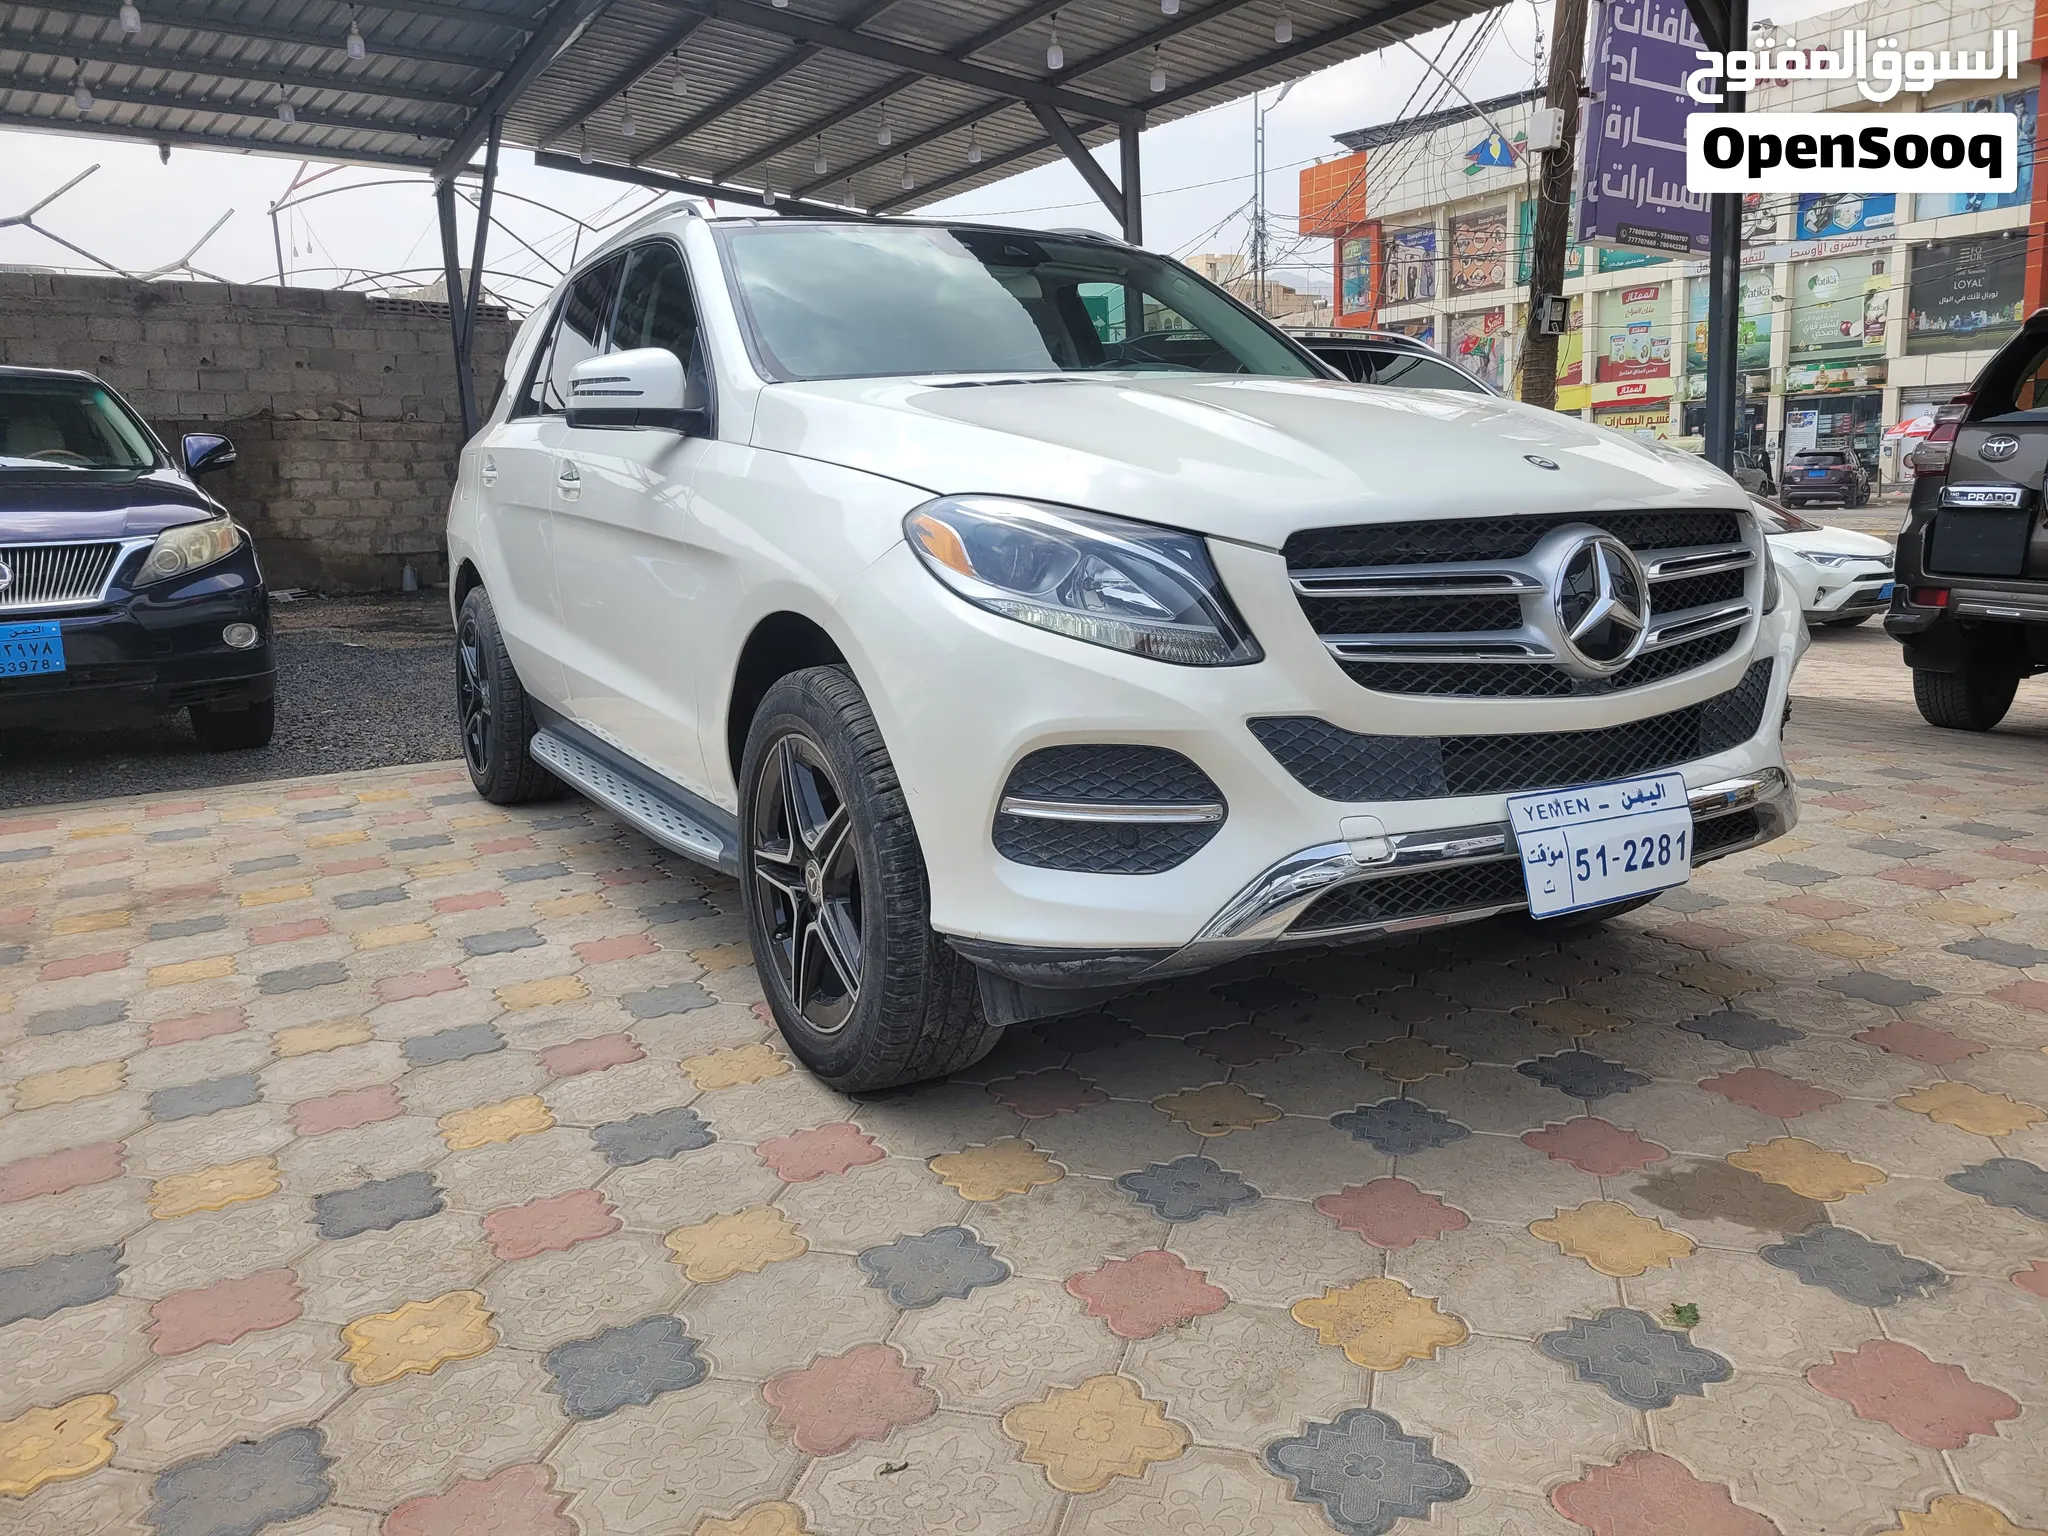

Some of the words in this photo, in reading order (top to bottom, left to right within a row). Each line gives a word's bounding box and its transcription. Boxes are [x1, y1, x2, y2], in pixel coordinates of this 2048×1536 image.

[1829, 236, 1863, 254] الشرق
[1865, 232, 1896, 246] مجمع
[1790, 241, 1827, 259] الأوسط
[1815, 276, 1837, 288] Vatika
[1953, 278, 1983, 290] LOYAL
[1625, 288, 1655, 303] الممتاز
[1954, 295, 1966, 305] في
[1620, 385, 1643, 395] الممتاز
[1605, 414, 1645, 429] البهارات
[1967, 493, 2014, 502] PRADO
[9, 625, 44, 638] اليمن
[1621, 782, 1667, 810] اليمن
[1523, 797, 1591, 822] YEMEN
[1576, 829, 1686, 882] 51-2281
[1543, 879, 1556, 894] ت
